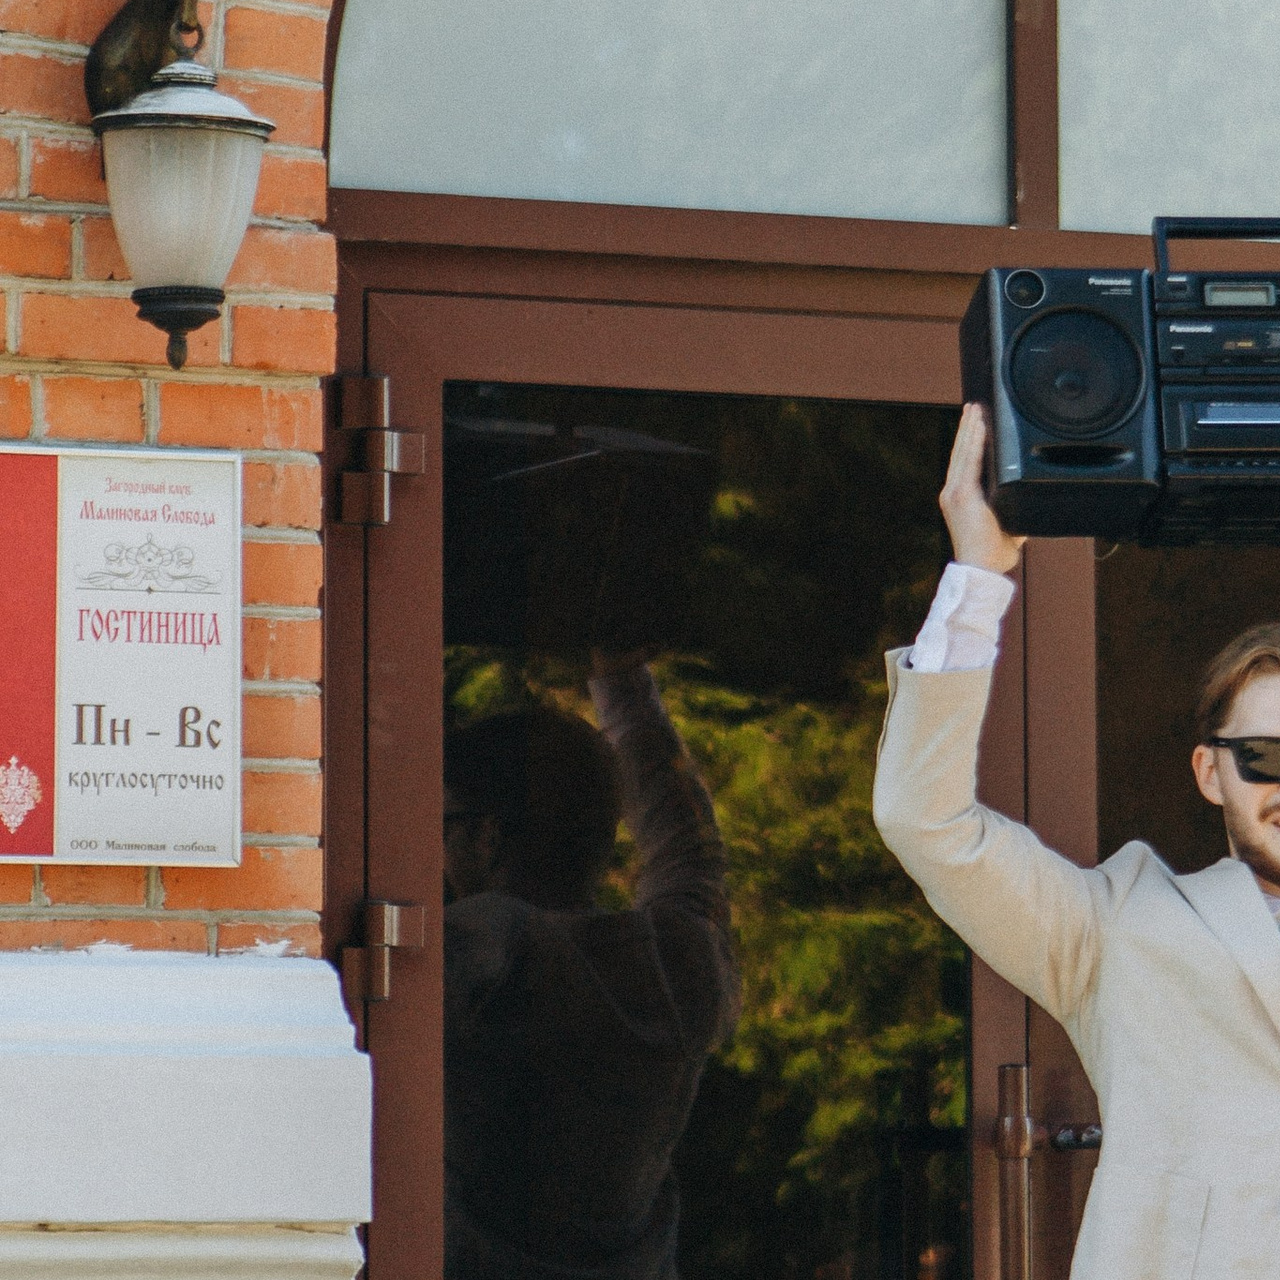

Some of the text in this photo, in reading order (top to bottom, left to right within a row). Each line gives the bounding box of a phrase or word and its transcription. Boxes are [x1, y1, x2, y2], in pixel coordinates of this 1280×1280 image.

[1087, 277, 1132, 287] Panasonic
[1169, 324, 1214, 333] Panasonic
[104, 476, 166, 495] Загородный
[79, 500, 217, 526] Малиновая Слобода
[76, 608, 222, 655] ГОСТИНИЦА
[71, 703, 131, 747] Пн
[175, 705, 222, 750] Вс
[67, 771, 225, 797] круглосуточно
[70, 839, 99, 851] ООО
[105, 839, 167, 852] Малиновая
